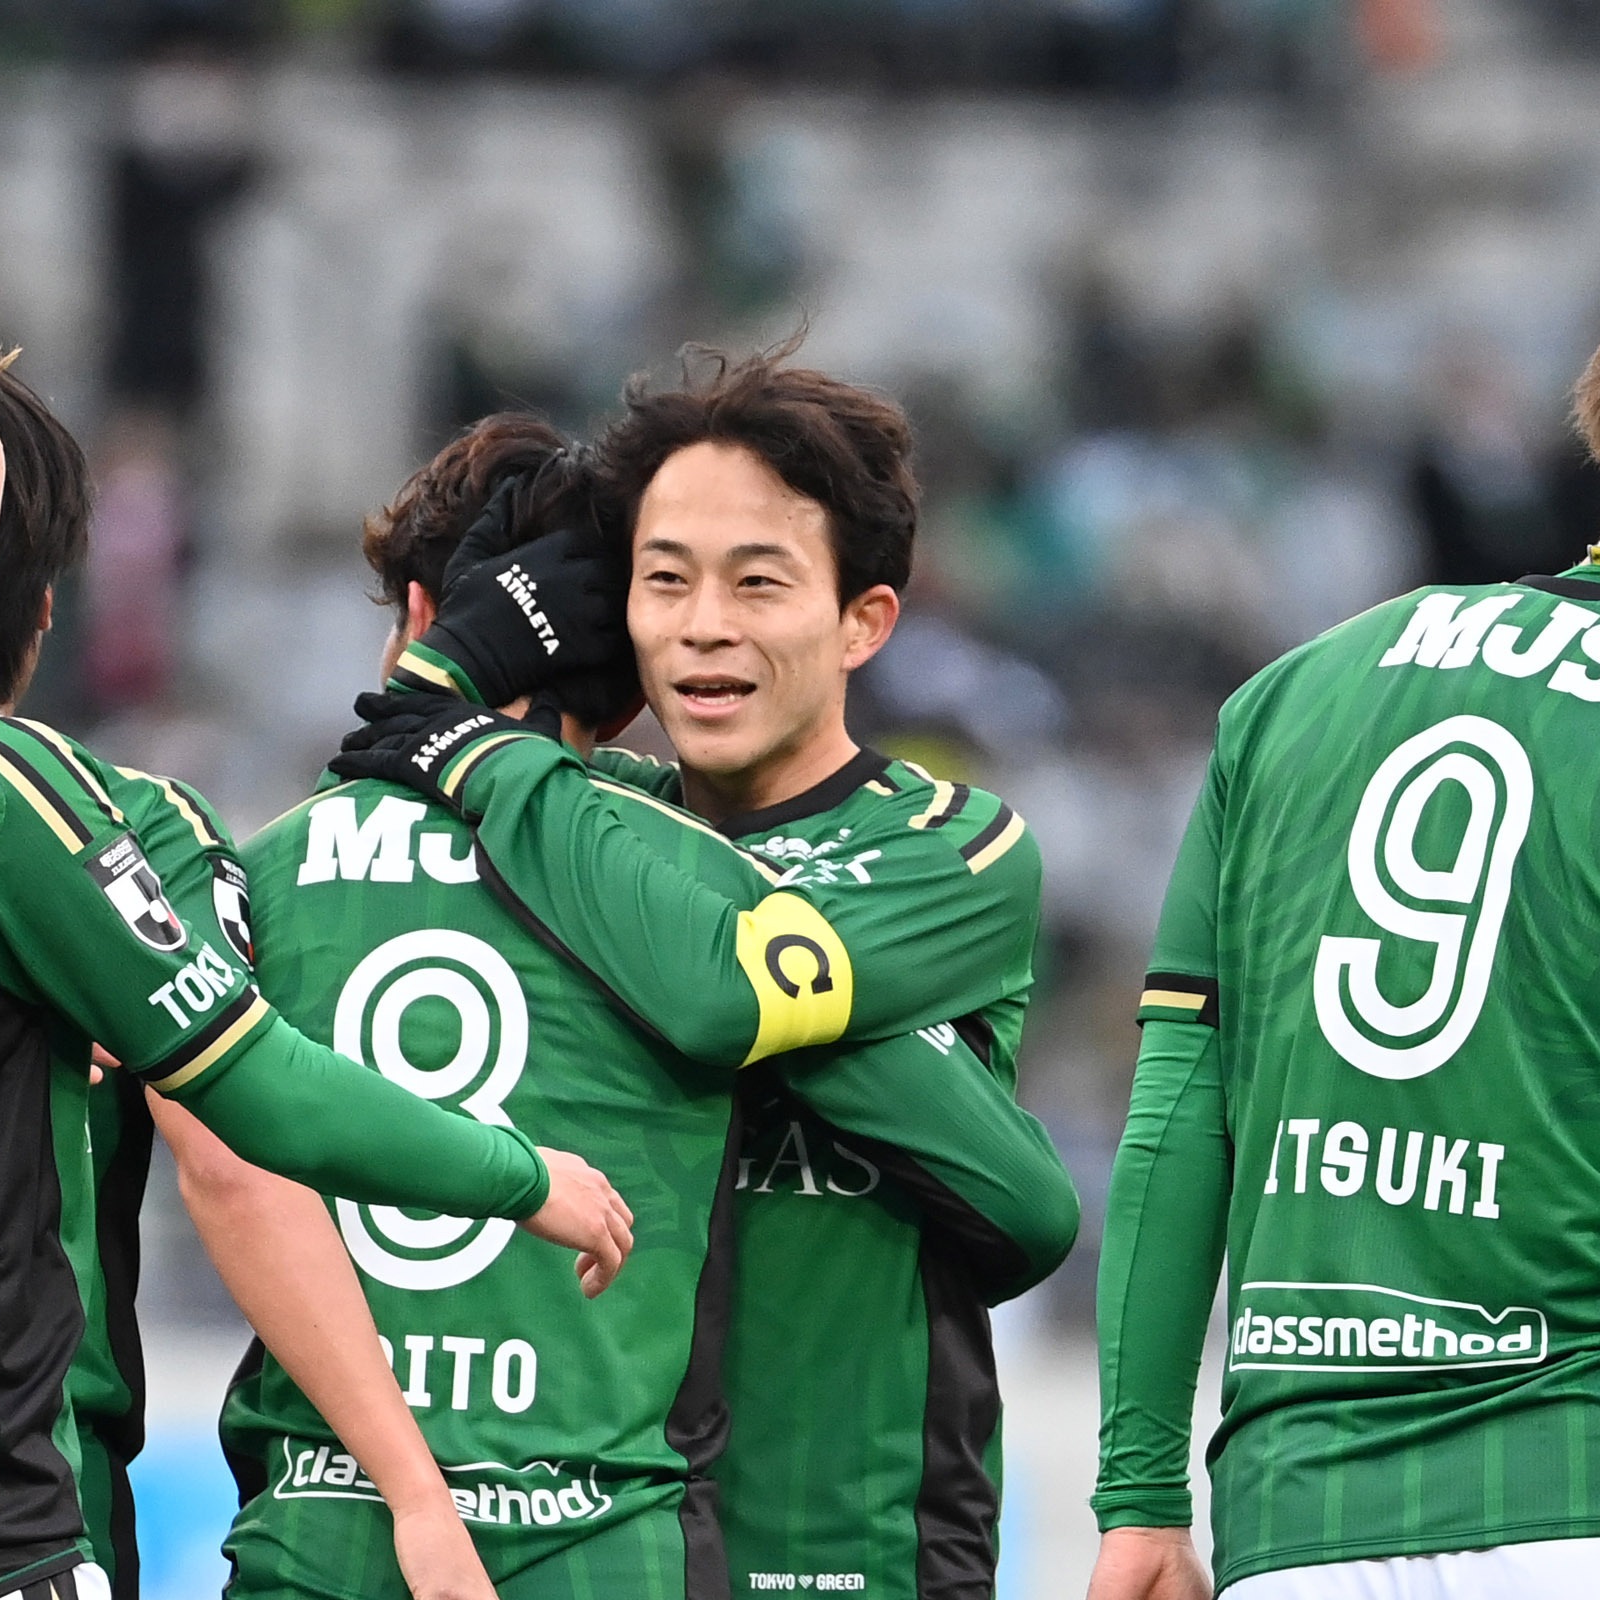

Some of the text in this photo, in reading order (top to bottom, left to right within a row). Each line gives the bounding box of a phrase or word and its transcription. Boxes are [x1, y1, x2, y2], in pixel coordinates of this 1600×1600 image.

[496, 570, 560, 655] ATHLETA
[416, 715, 495, 772] ATHLETA
[1315, 715, 1534, 1079] 9
[765, 934, 833, 999] C
[334, 929, 528, 1291] 8
[1264, 1119, 1505, 1219] ITSUKI
[1234, 1308, 1531, 1357] classmethod
[293, 1447, 595, 1525] claethod
[749, 1573, 864, 1590] TOKYO GREEN
